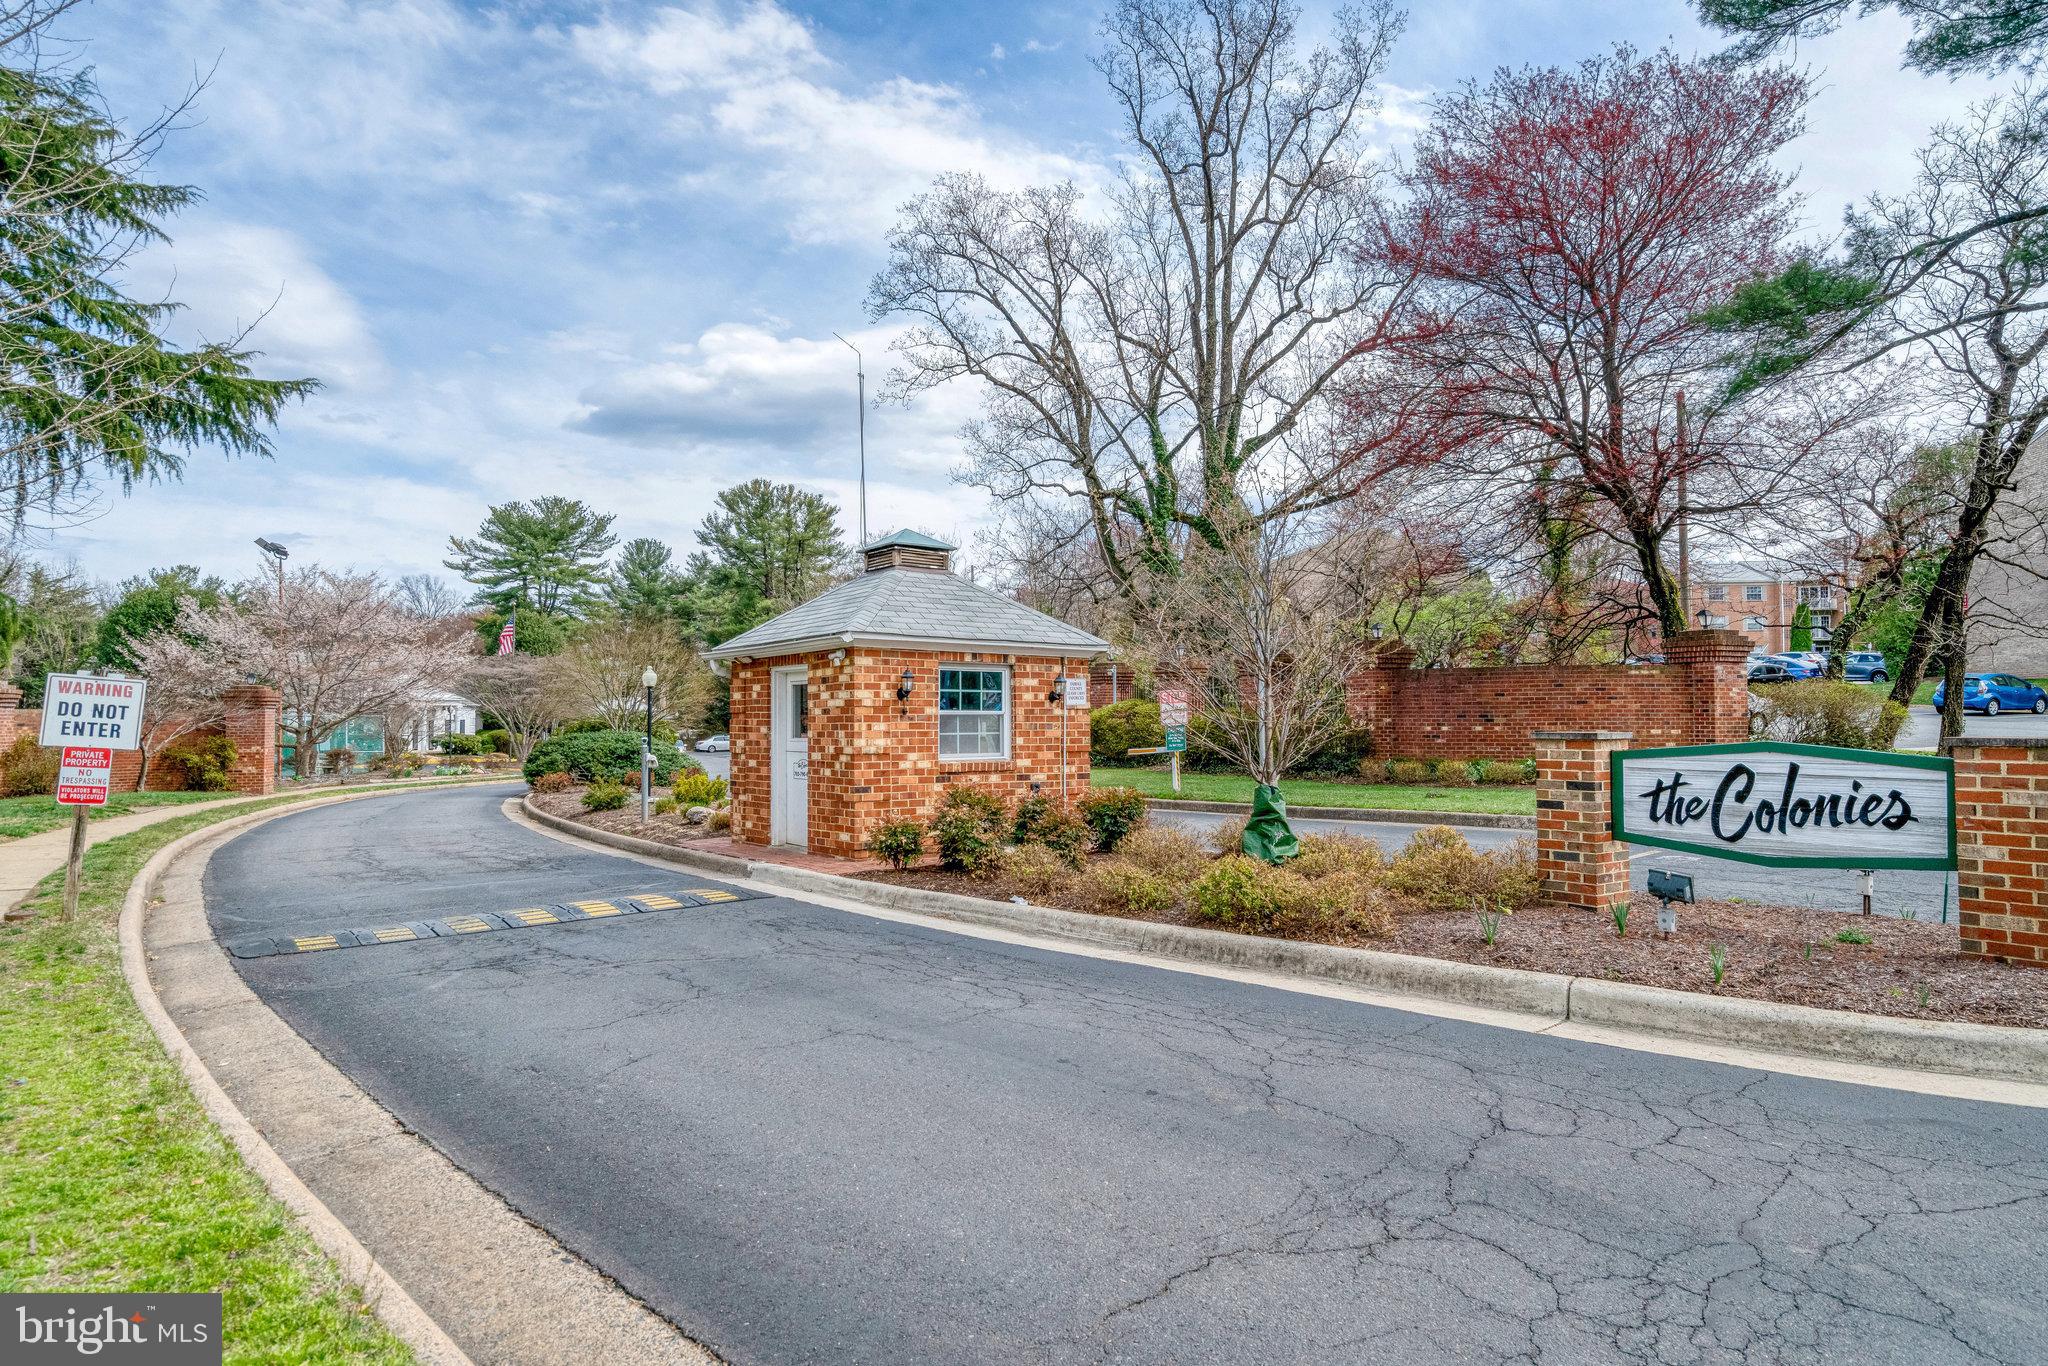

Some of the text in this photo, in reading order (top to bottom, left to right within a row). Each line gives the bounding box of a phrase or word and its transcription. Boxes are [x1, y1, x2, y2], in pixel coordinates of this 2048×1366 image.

[58, 680, 133, 698] WARNING
[57, 701, 130, 720] DO NOT
[60, 720, 121, 738] ENTER
[70, 750, 105, 759] PRIVATE
[65, 758, 108, 767] PROPERTY
[78, 769, 93, 777] NO
[61, 776, 107, 785] TRESPASSING
[1638, 761, 1920, 842] the Colonies
